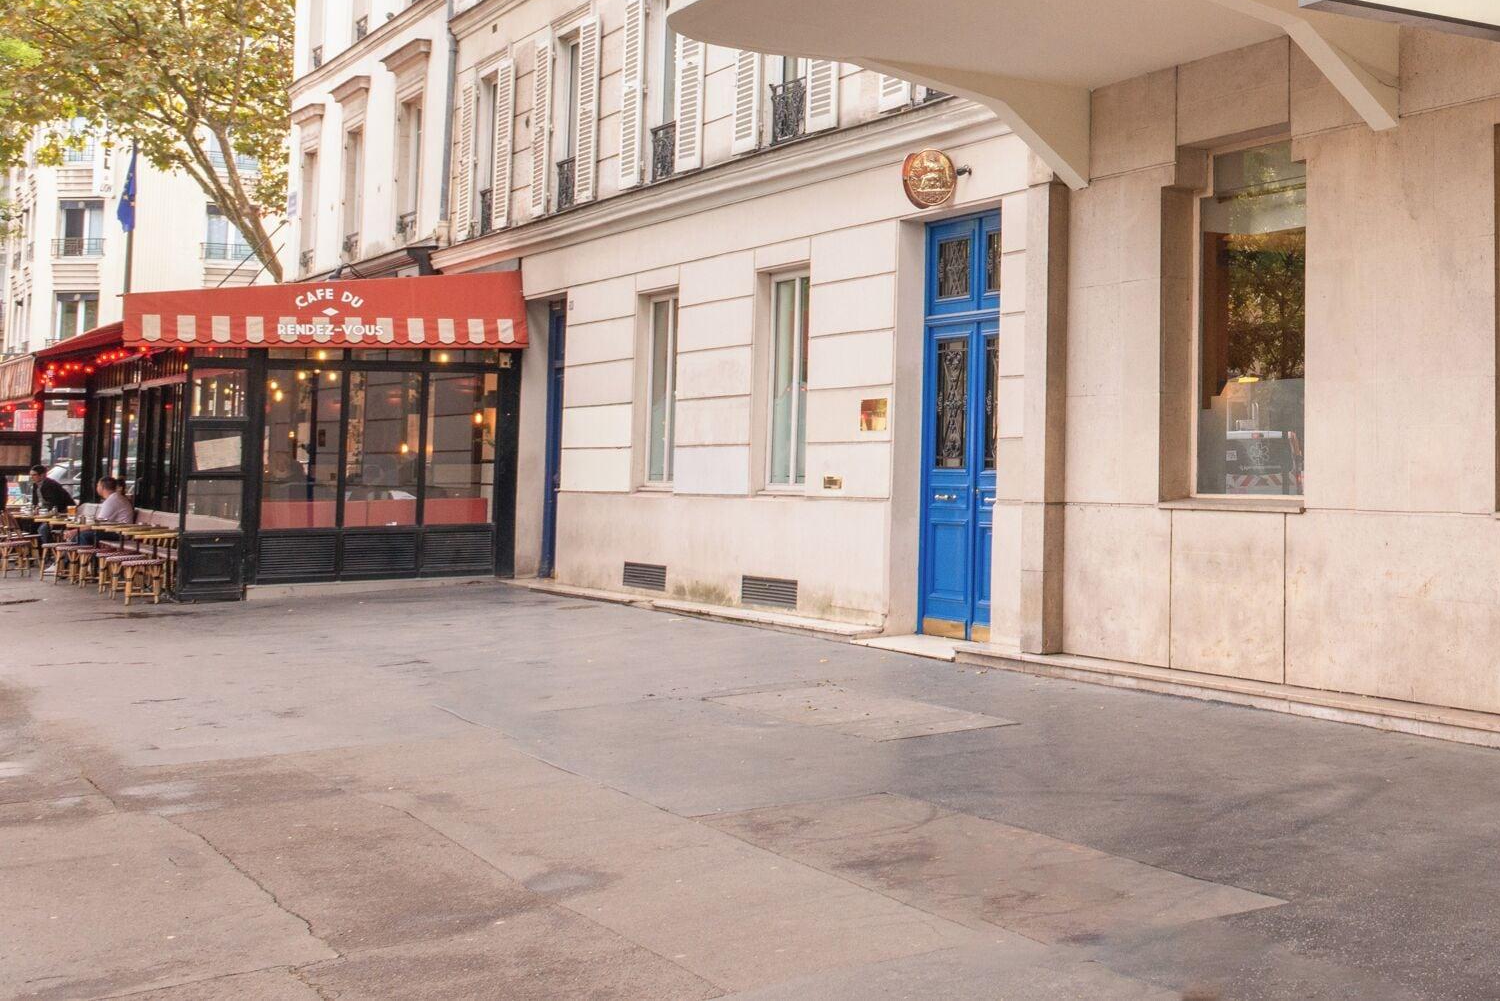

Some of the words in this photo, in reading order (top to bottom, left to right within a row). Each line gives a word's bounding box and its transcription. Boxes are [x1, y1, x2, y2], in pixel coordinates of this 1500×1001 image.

[295, 288, 334, 308] CAFE
[341, 291, 364, 308] DU
[277, 324, 384, 336] RENDEZ-VOUS
